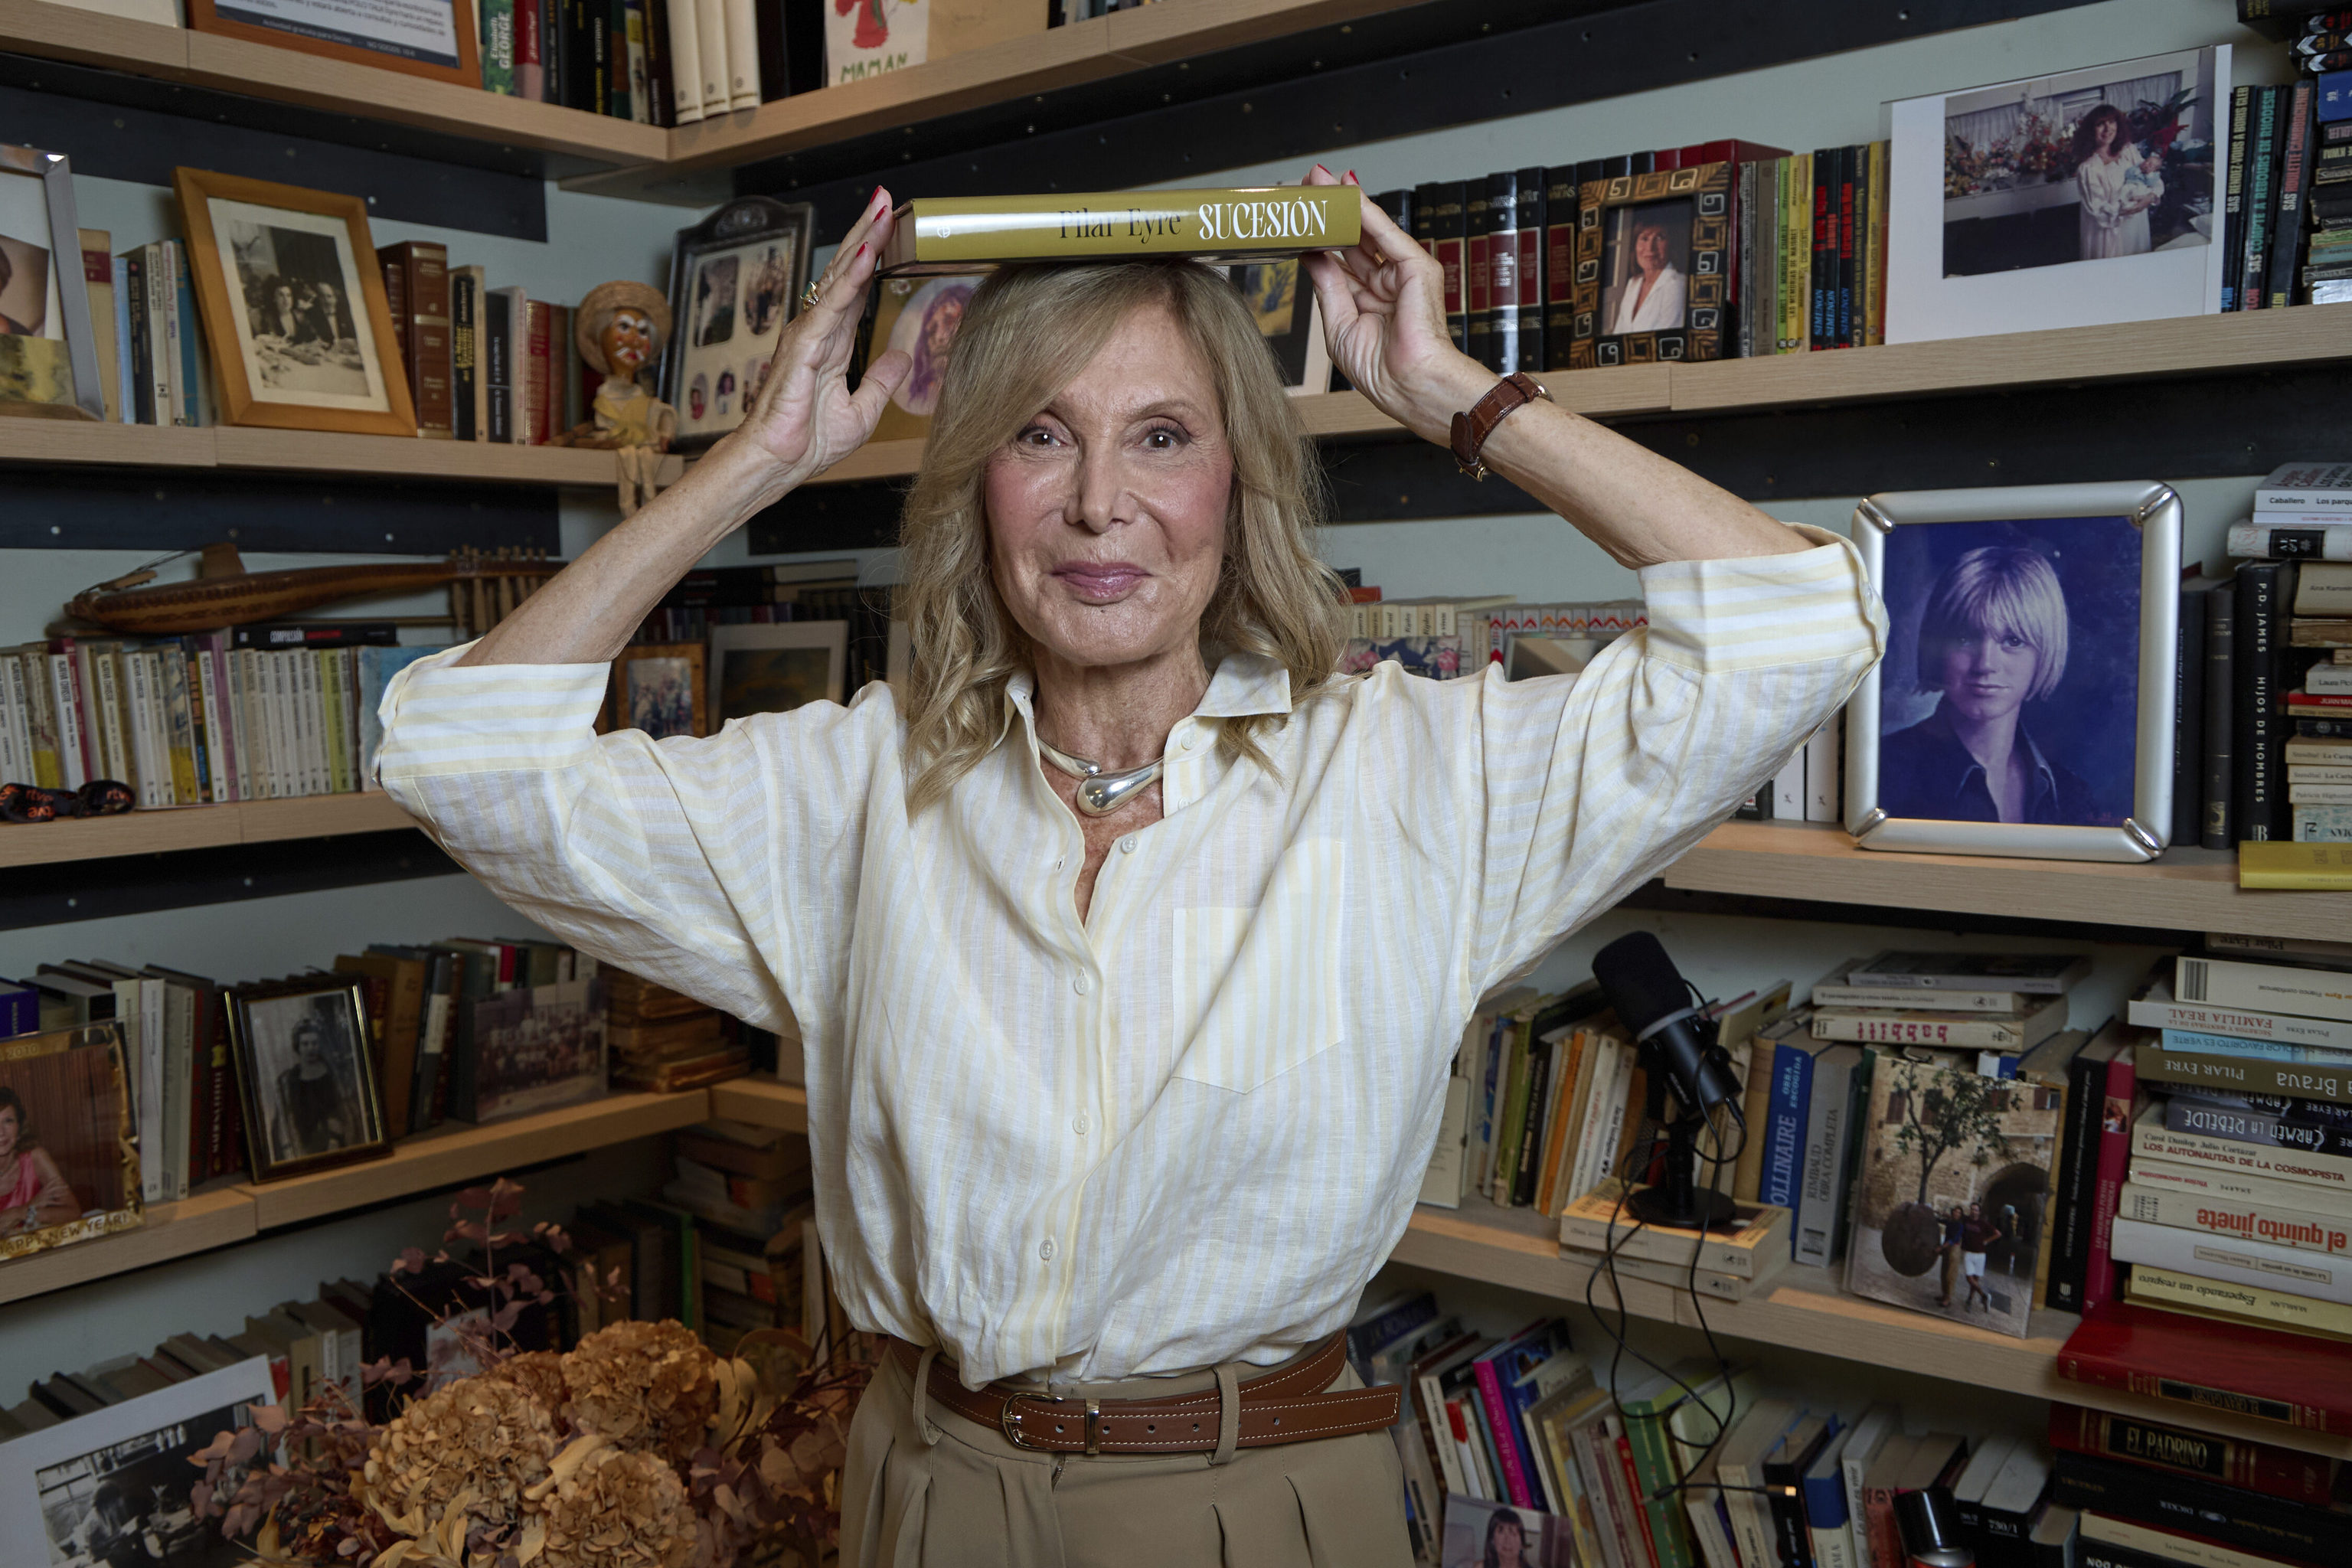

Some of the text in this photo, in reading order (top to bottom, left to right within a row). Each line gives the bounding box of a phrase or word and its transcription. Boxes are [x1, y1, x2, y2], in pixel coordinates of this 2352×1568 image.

[498, 11, 511, 70] GEORGE
[2235, 86, 2250, 108] GLEB
[2233, 109, 2249, 132] BORIS
[2259, 89, 2277, 138] RHODESIE
[2258, 139, 2272, 155] EN
[2229, 140, 2247, 194] RENDEZ-VOUS
[2254, 156, 2271, 199] REBOURS
[2285, 152, 2303, 193] ROULETTE
[2227, 194, 2240, 214] SAS
[2282, 194, 2297, 211] SAS
[1059, 196, 1328, 245] Pilar Eyre SUCESIÓN
[2250, 211, 2265, 252] COMPTE
[2248, 254, 2262, 273] SAS
[1814, 289, 1824, 335] SIMENON
[1840, 287, 1851, 336] SIMENON
[2272, 292, 2286, 309] LON
[1825, 290, 1836, 337] SIMENON
[2256, 582, 2267, 652] P.D. JAMES
[270, 628, 305, 643] COMPULSIÓN
[2255, 676, 2265, 802] HIJOS DE HOMBRES
[2256, 939, 2284, 950] Pilar
[2168, 1008, 2272, 1029] FAMILIA REAL
[2172, 1036, 2202, 1046] VERTE
[2217, 1039, 2264, 1050] FAVORITO
[2265, 1043, 2301, 1054] COLOR
[1781, 1067, 1792, 1095] OBRA
[2164, 1060, 2245, 1080] PILAR EYRE
[1789, 1056, 1803, 1109] ESCOGIDA
[2276, 1072, 2337, 1096] Brava
[2305, 1102, 2331, 1115] EYRE
[2184, 1109, 2324, 1146] CARMEN LA REBELDE
[2144, 1132, 2220, 1151] Carol Dunlop Julio
[1769, 1115, 1797, 1206] OLLINAIRE
[1819, 1109, 1838, 1202] OBRA COMPLETA
[2144, 1142, 2346, 1182] LOS AUTONAUTAS DE LA COSMOPISTA
[1806, 1144, 1821, 1200] RIMBAUD
[49, 1225, 81, 1240] NEW
[86, 1213, 128, 1233] YEAR!
[2196, 1207, 2347, 1252] el quinto jinete
[2138, 1272, 2177, 1289] respiro
[2179, 1282, 2194, 1292] un
[2196, 1285, 2256, 1306] Esperando
[2190, 1387, 2223, 1408] GATSBY
[2251, 1400, 2259, 1414] EL
[2125, 1426, 2209, 1469] EL PADRINO
[2159, 1500, 2194, 1515] DICKER
